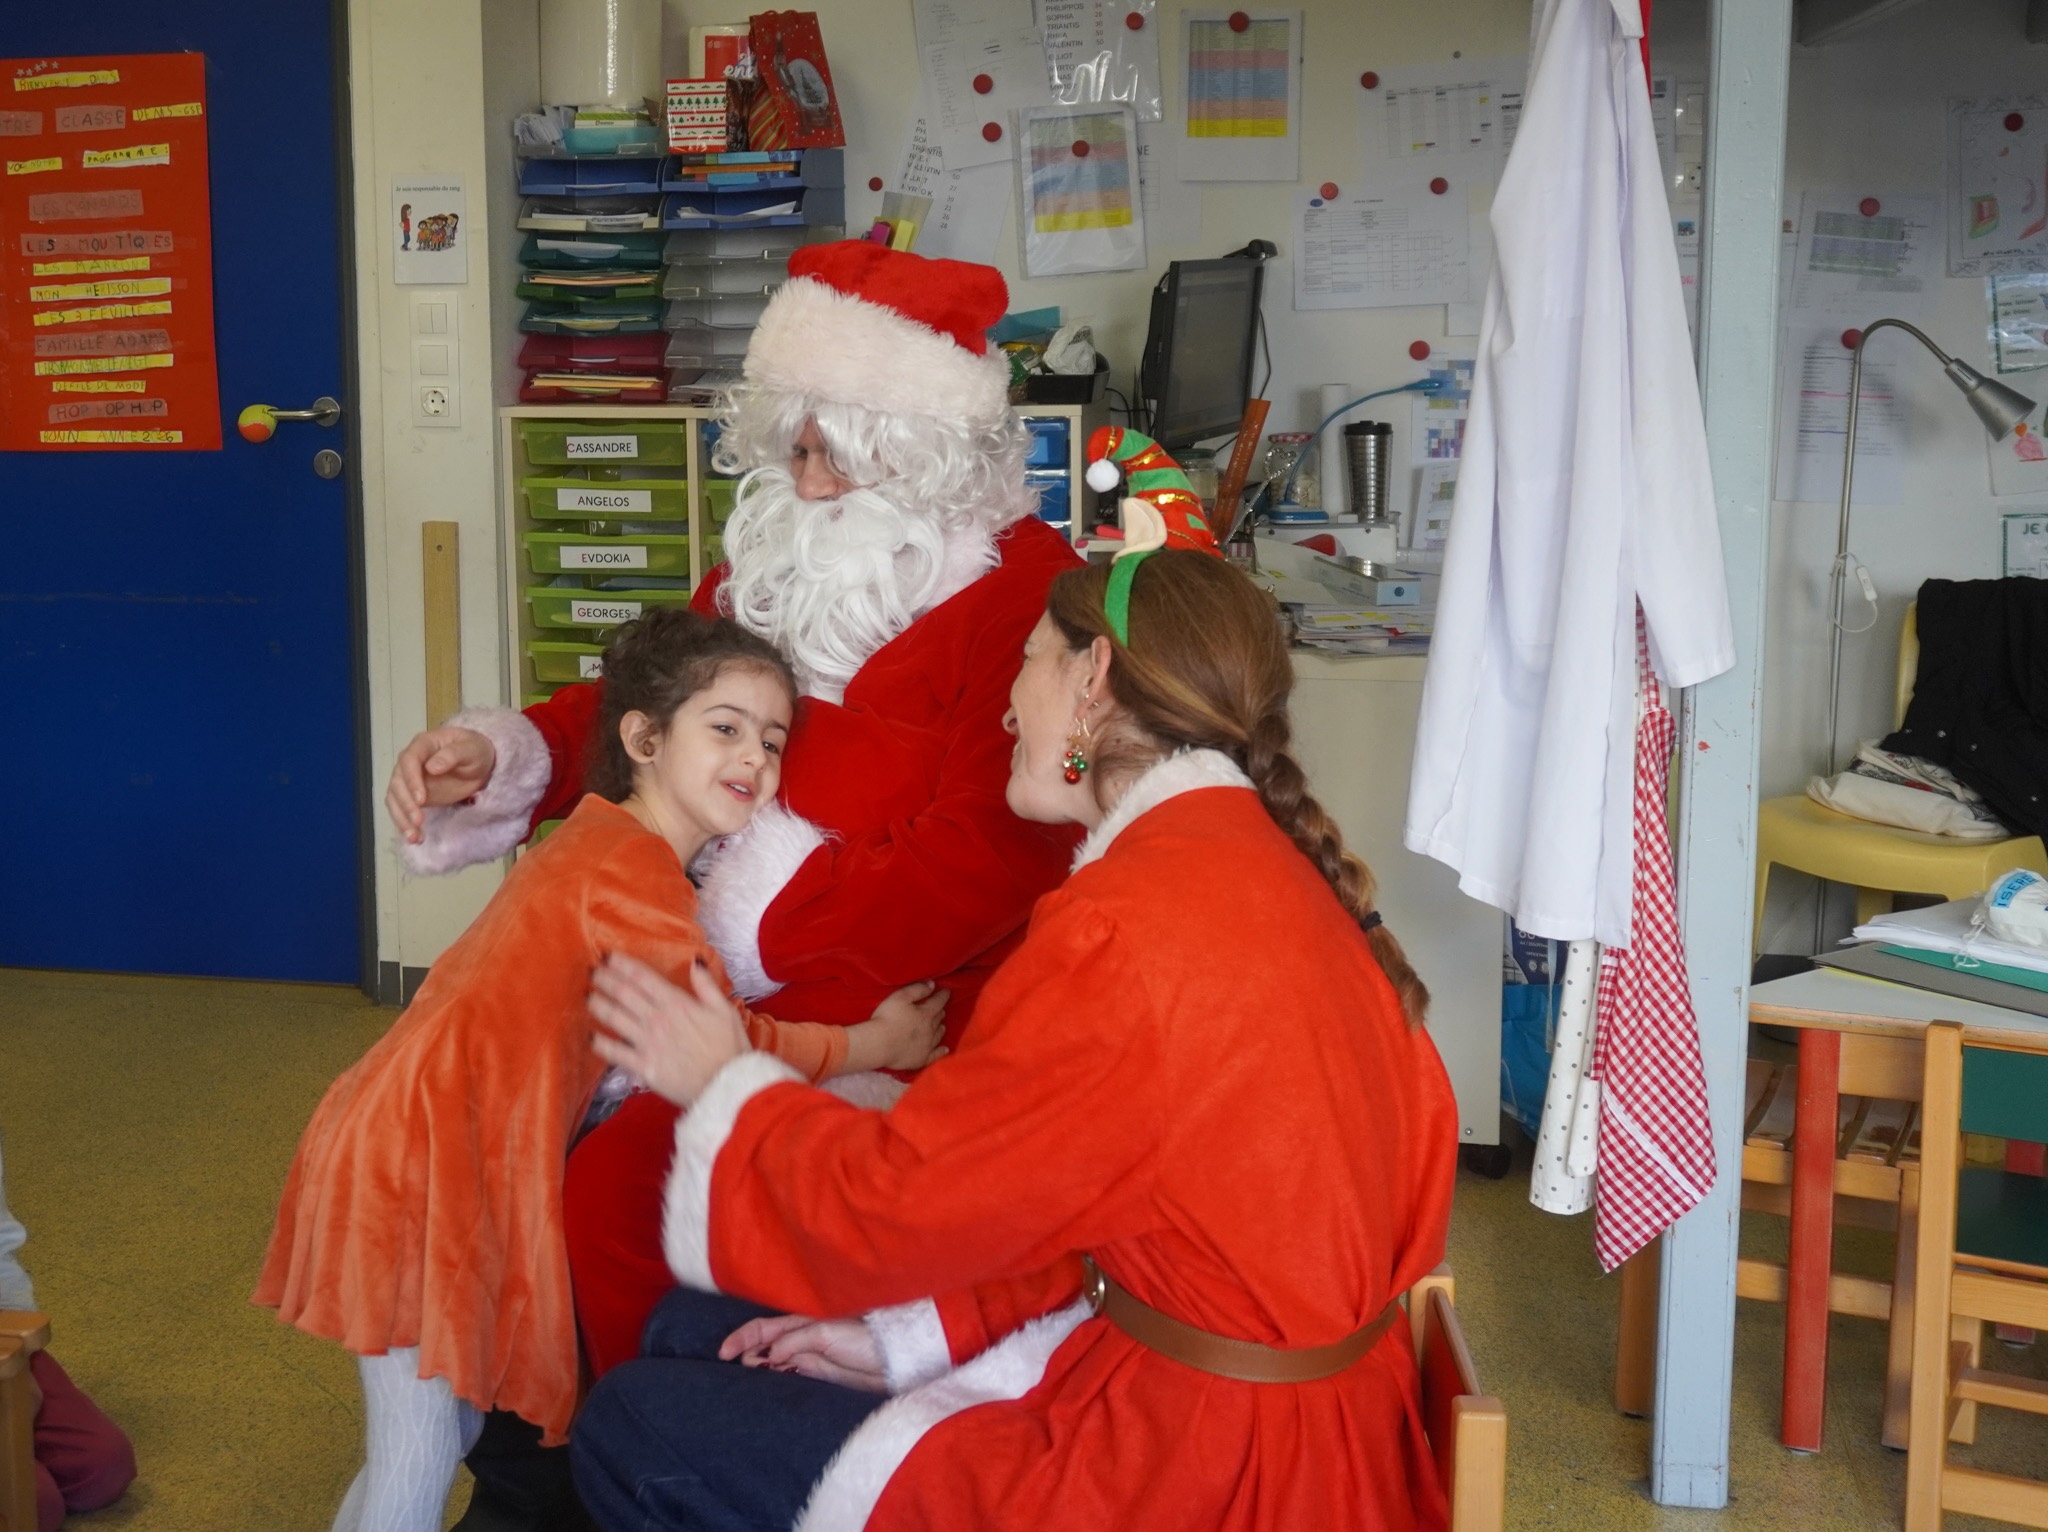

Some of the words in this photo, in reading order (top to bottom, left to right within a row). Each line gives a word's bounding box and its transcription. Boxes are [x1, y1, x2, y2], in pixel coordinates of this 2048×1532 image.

[1046, 3, 1084, 12] PHILIPPOS
[1046, 13, 1074, 21] SOPHIA
[1047, 22, 1080, 30] TRIANTIS
[1047, 40, 1084, 49] VALENTIN
[0, 119, 32, 133] TRE
[61, 110, 124, 127] CLASSE
[33, 200, 60, 217] LES
[27, 238, 55, 253] LES
[34, 262, 60, 274] LES
[76, 259, 149, 273] MARRONS
[36, 289, 60, 300] MON
[86, 283, 140, 297] HERISSON
[39, 311, 65, 324] LES
[36, 334, 103, 352] FAMILLE
[116, 330, 168, 347] ADAMS
[55, 382, 92, 392] DEFILE
[97, 381, 109, 391] DE
[115, 381, 145, 391] MODE
[56, 403, 90, 420] HOP
[130, 399, 163, 412] HOP
[566, 441, 632, 453] CASSANDRE
[577, 495, 630, 508] ANGELOS
[2022, 522, 2040, 535] JE
[581, 552, 631, 564] EVDOKIA
[577, 607, 631, 619] GEORGES
[1997, 873, 2035, 908] ISERE
